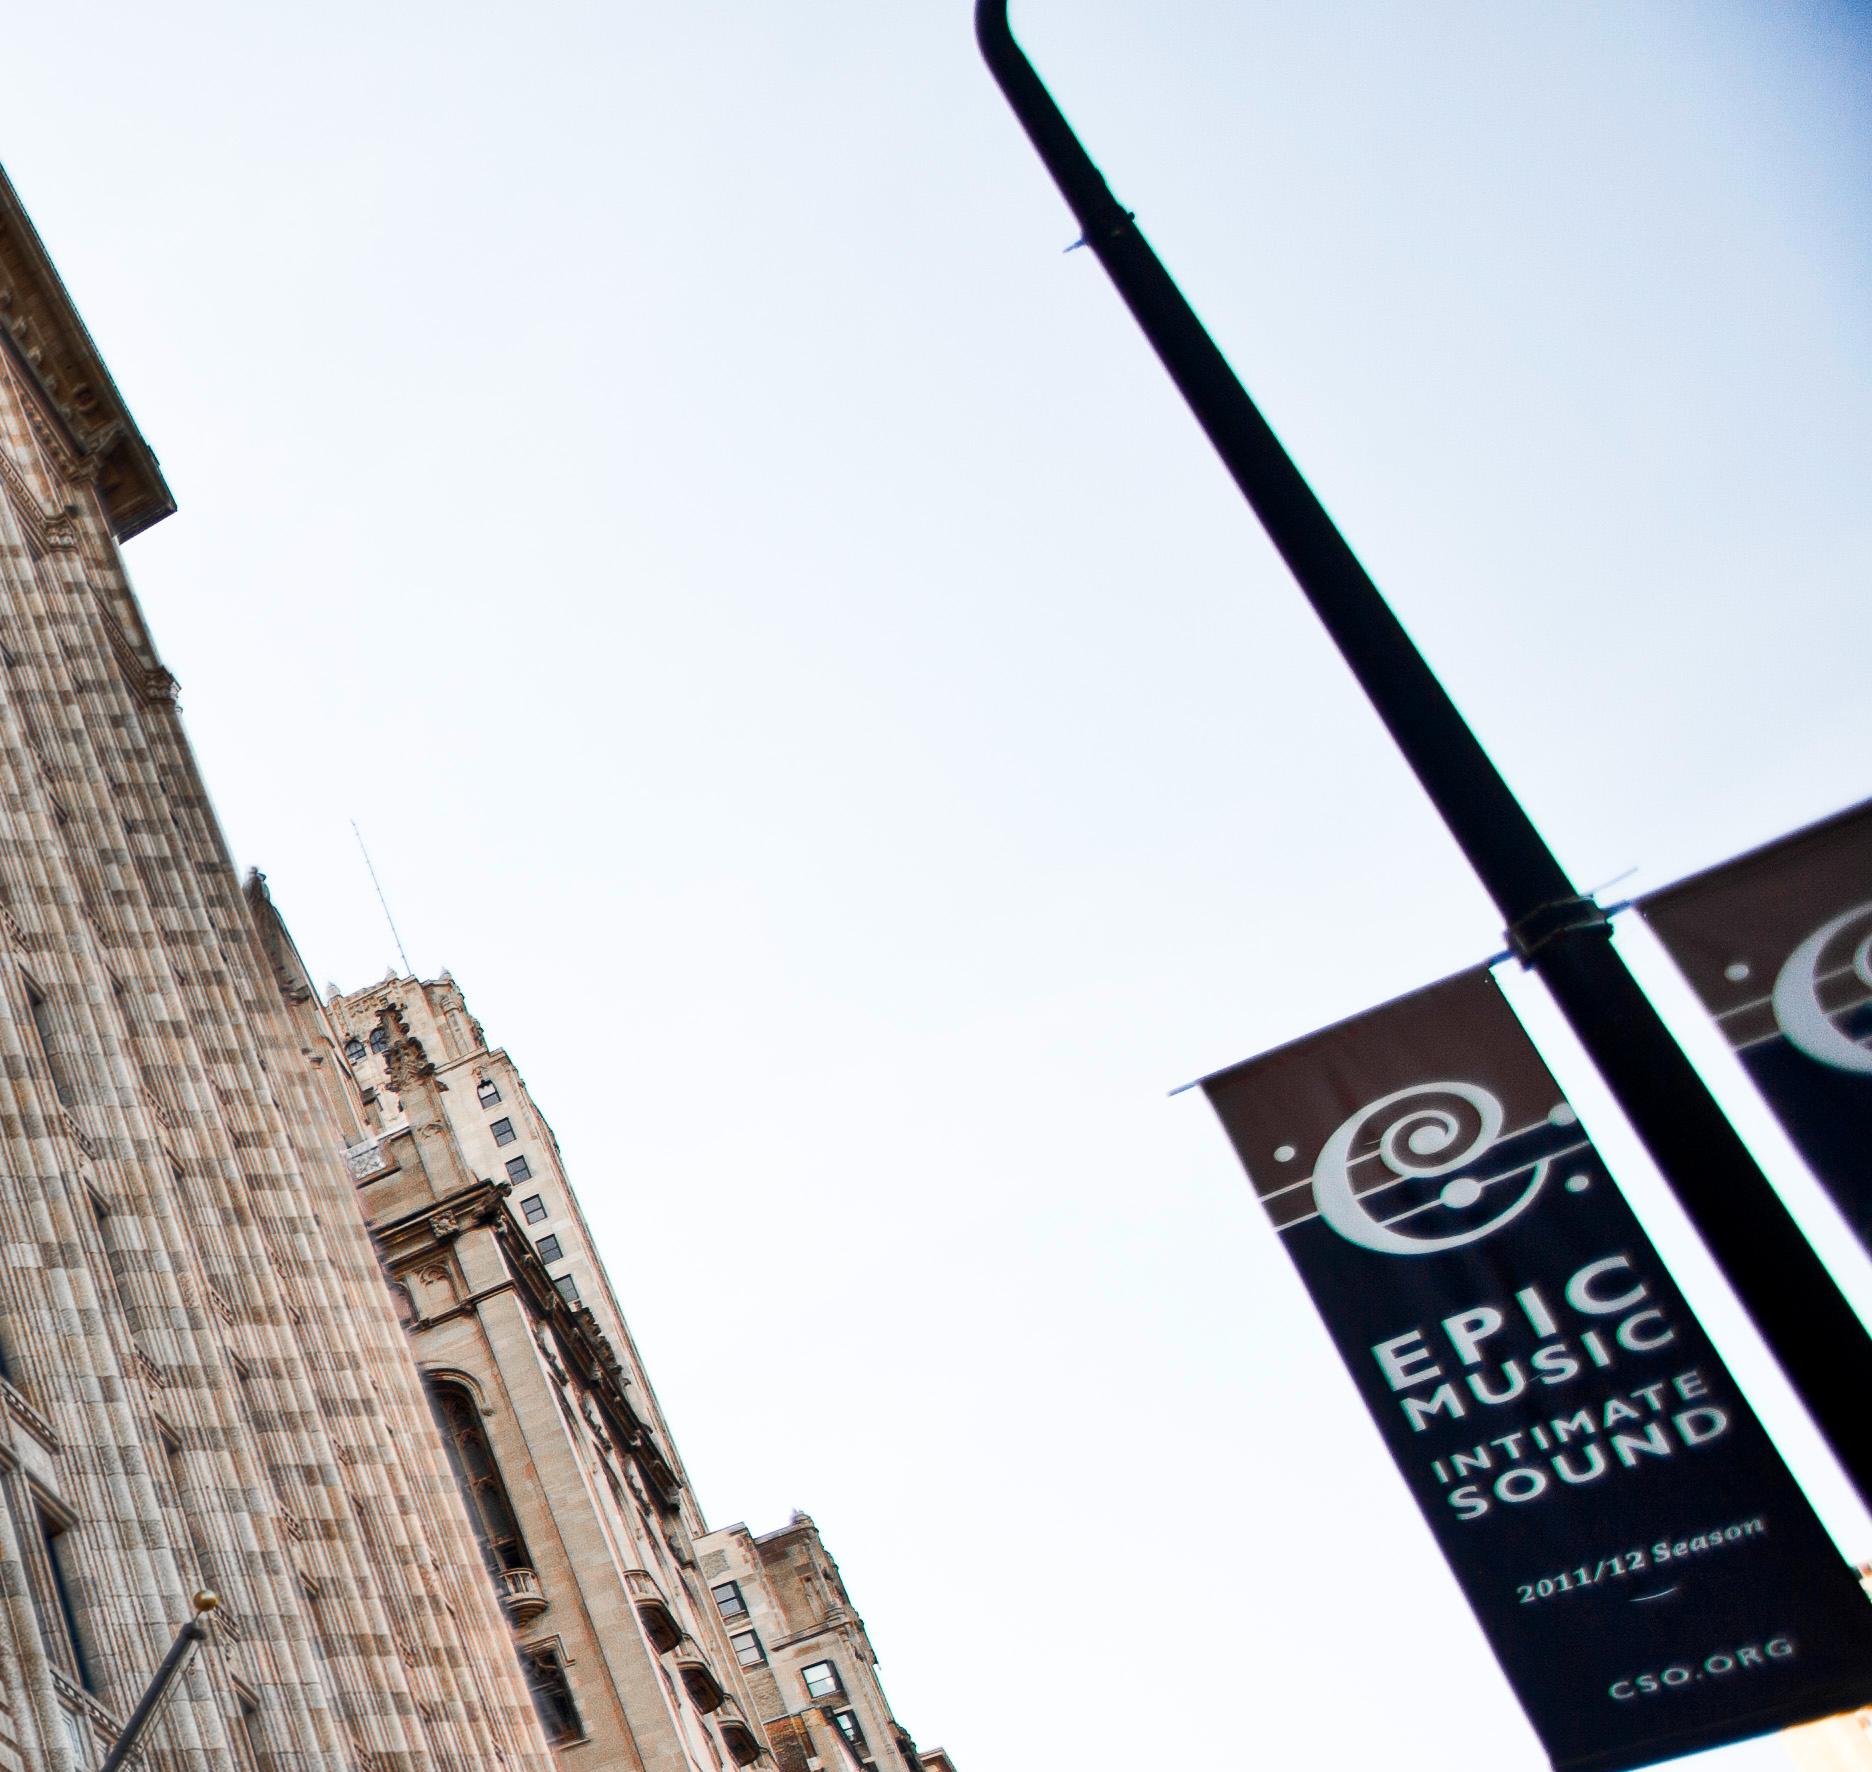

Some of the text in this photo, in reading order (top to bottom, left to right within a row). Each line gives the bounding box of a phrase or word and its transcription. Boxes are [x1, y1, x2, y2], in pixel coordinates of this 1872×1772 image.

[1371, 1255, 1649, 1394] EPIC
[1400, 1310, 1675, 1433] MUSIC
[1431, 1370, 1712, 1484] INTIMATE
[1447, 1405, 1730, 1521] SOUND
[1516, 1516, 1766, 1605] 2011/12 Season
[1608, 1636, 1795, 1701] CSO.ORG
